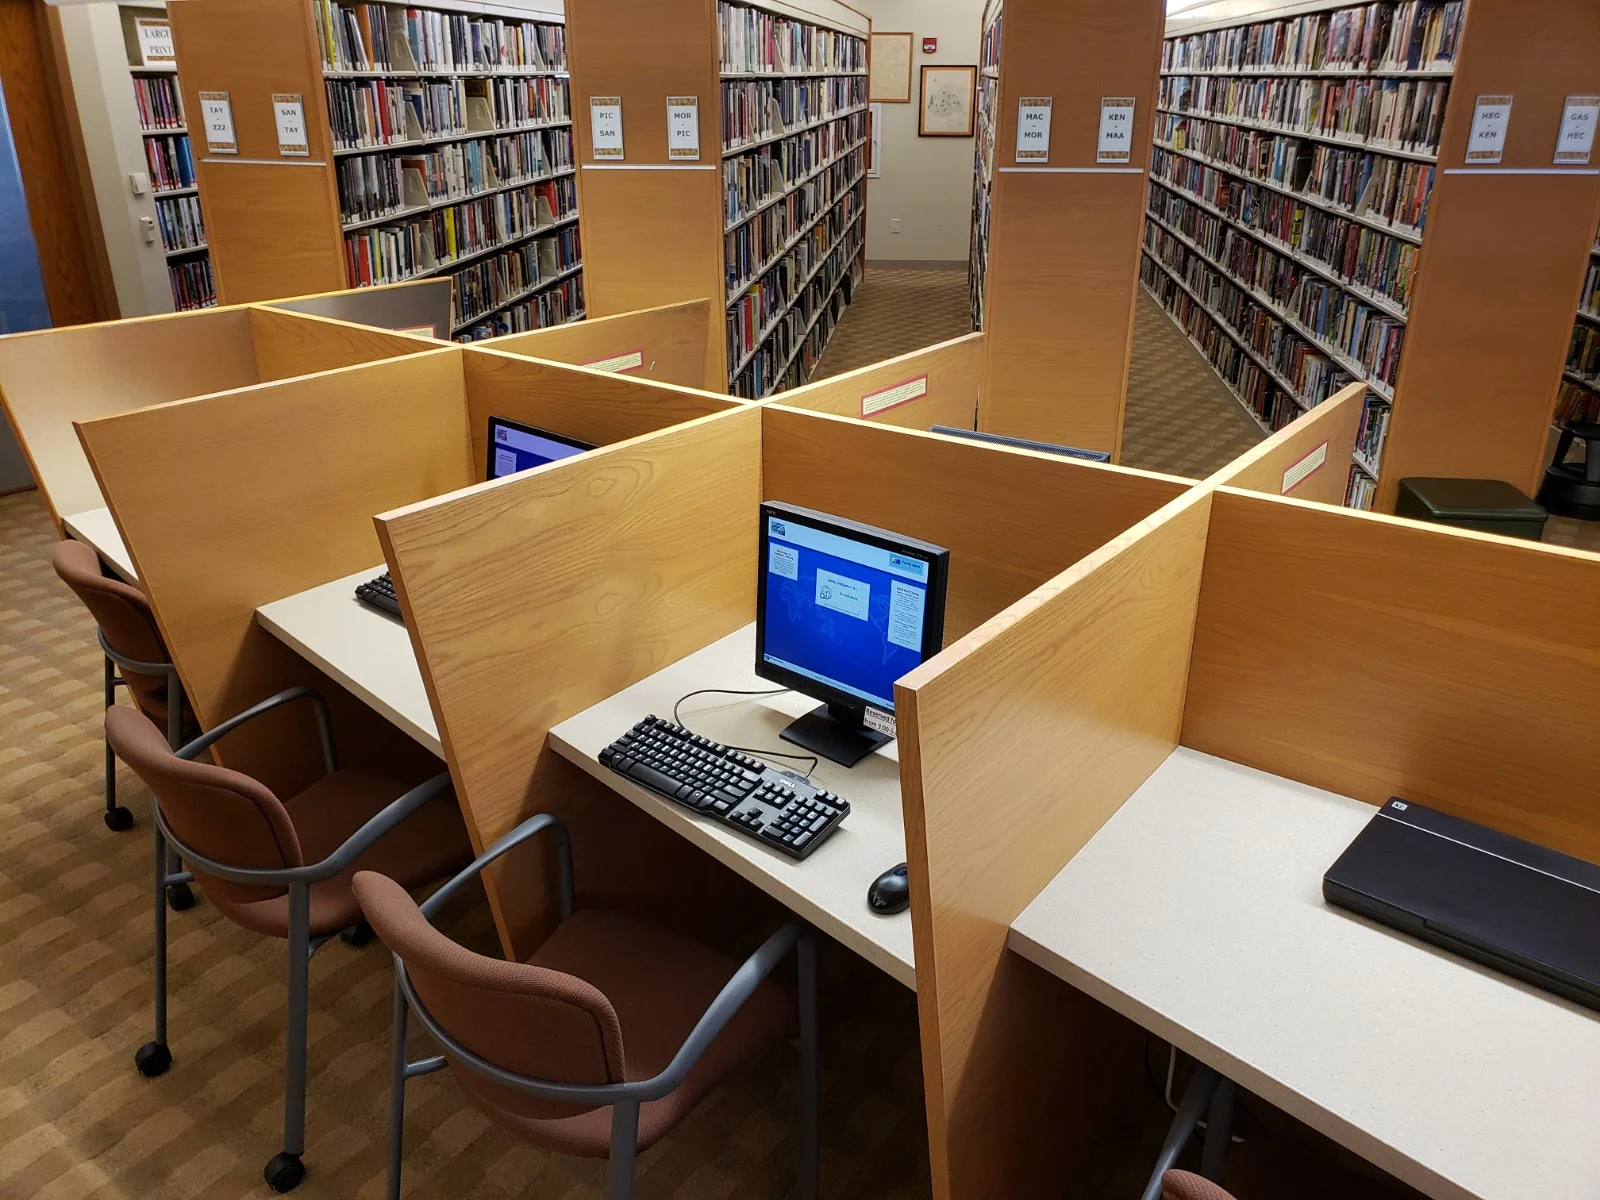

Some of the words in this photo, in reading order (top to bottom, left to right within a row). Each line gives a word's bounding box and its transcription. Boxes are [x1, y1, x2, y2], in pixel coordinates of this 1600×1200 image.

[144, 29, 170, 39] LARGE
[149, 45, 172, 55] PRINT
[1481, 112, 1501, 120] HEG
[1570, 113, 1589, 121] GAS
[1478, 131, 1497, 139] KEN
[1566, 132, 1585, 140] HEC
[865, 708, 891, 722] Reserved
[778, 778, 796, 789] DELL
